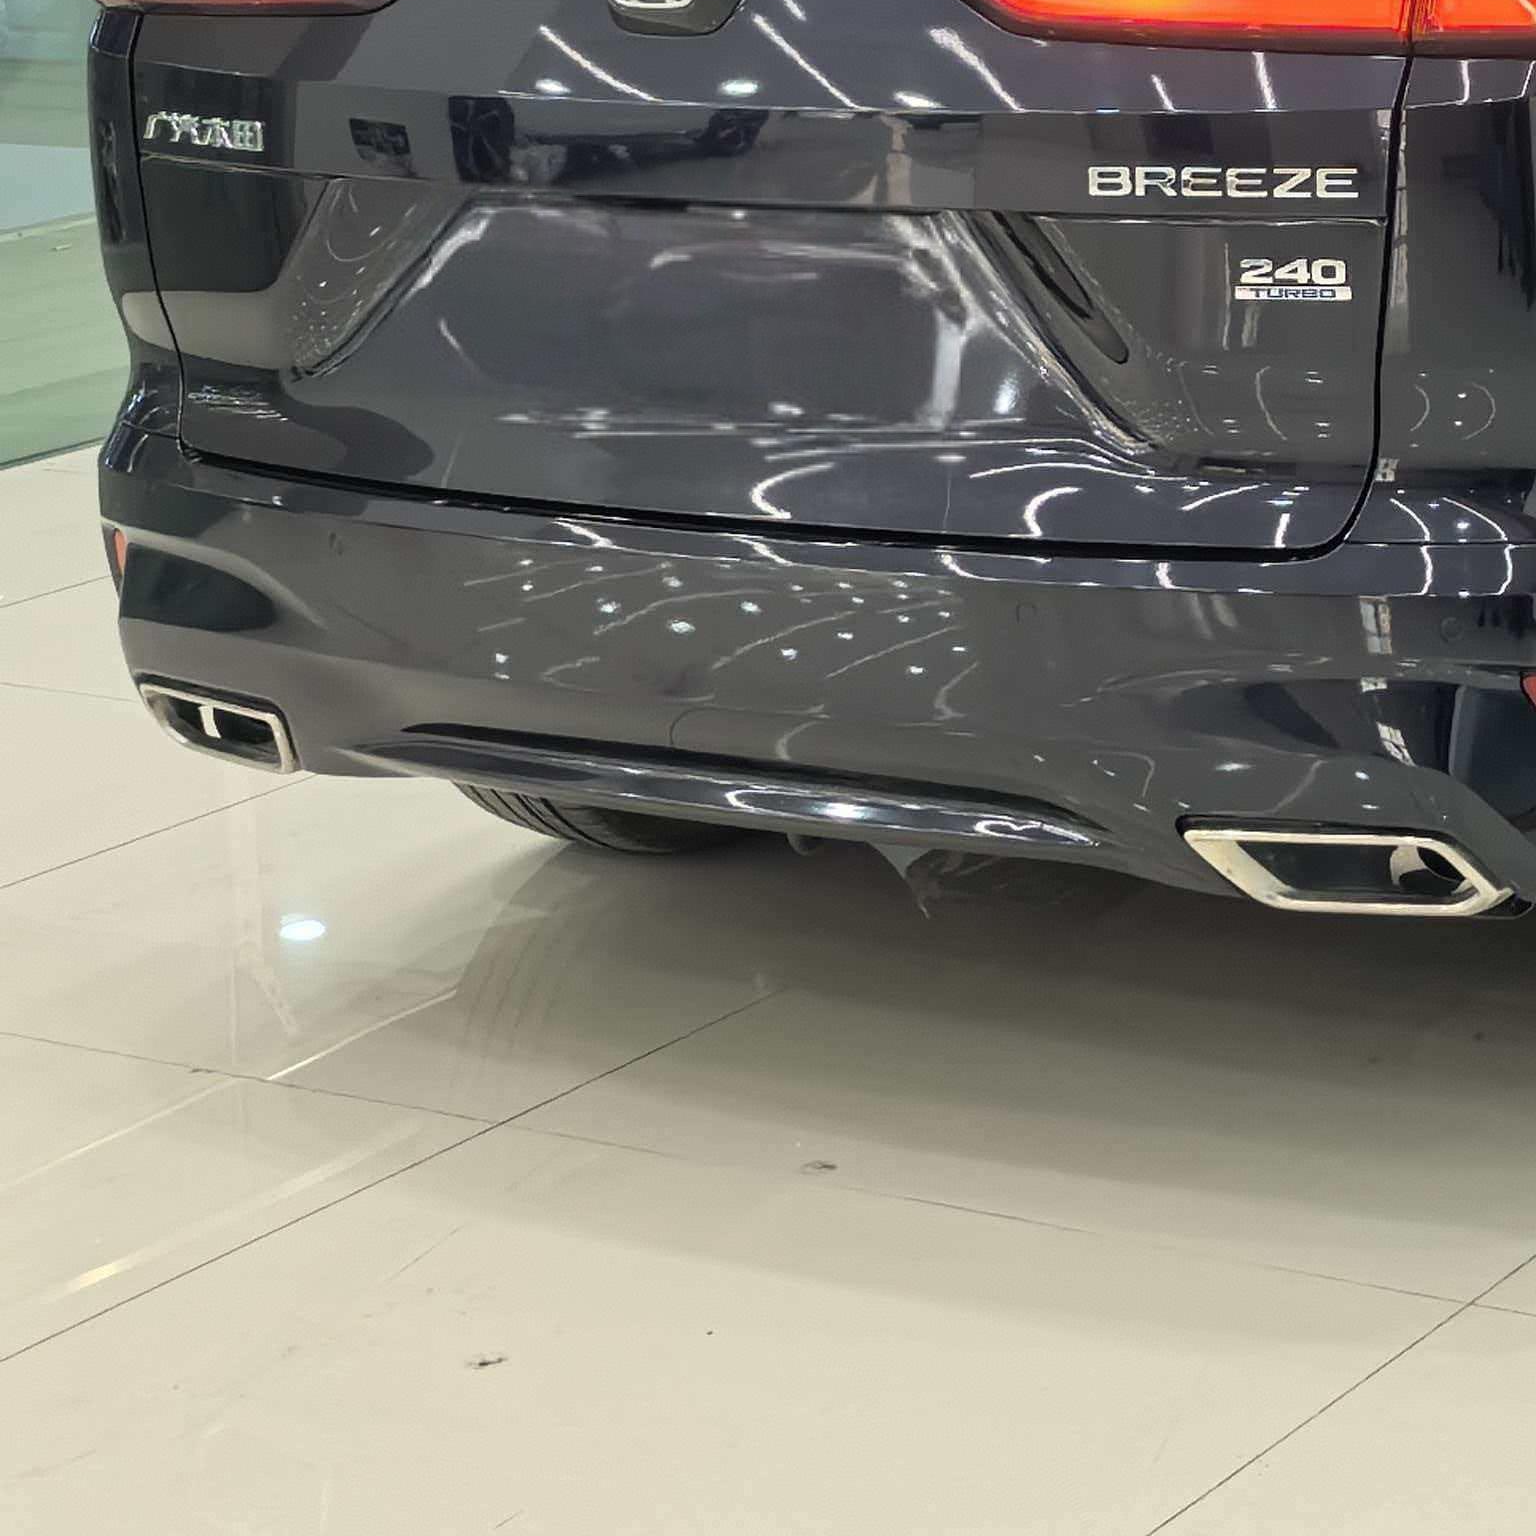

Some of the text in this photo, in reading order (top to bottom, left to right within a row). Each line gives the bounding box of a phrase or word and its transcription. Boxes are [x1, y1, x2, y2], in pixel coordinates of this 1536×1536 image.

[1088, 166, 1359, 198] BREEZE
[1240, 258, 1346, 284] 240
[1247, 287, 1339, 299] TURBO
